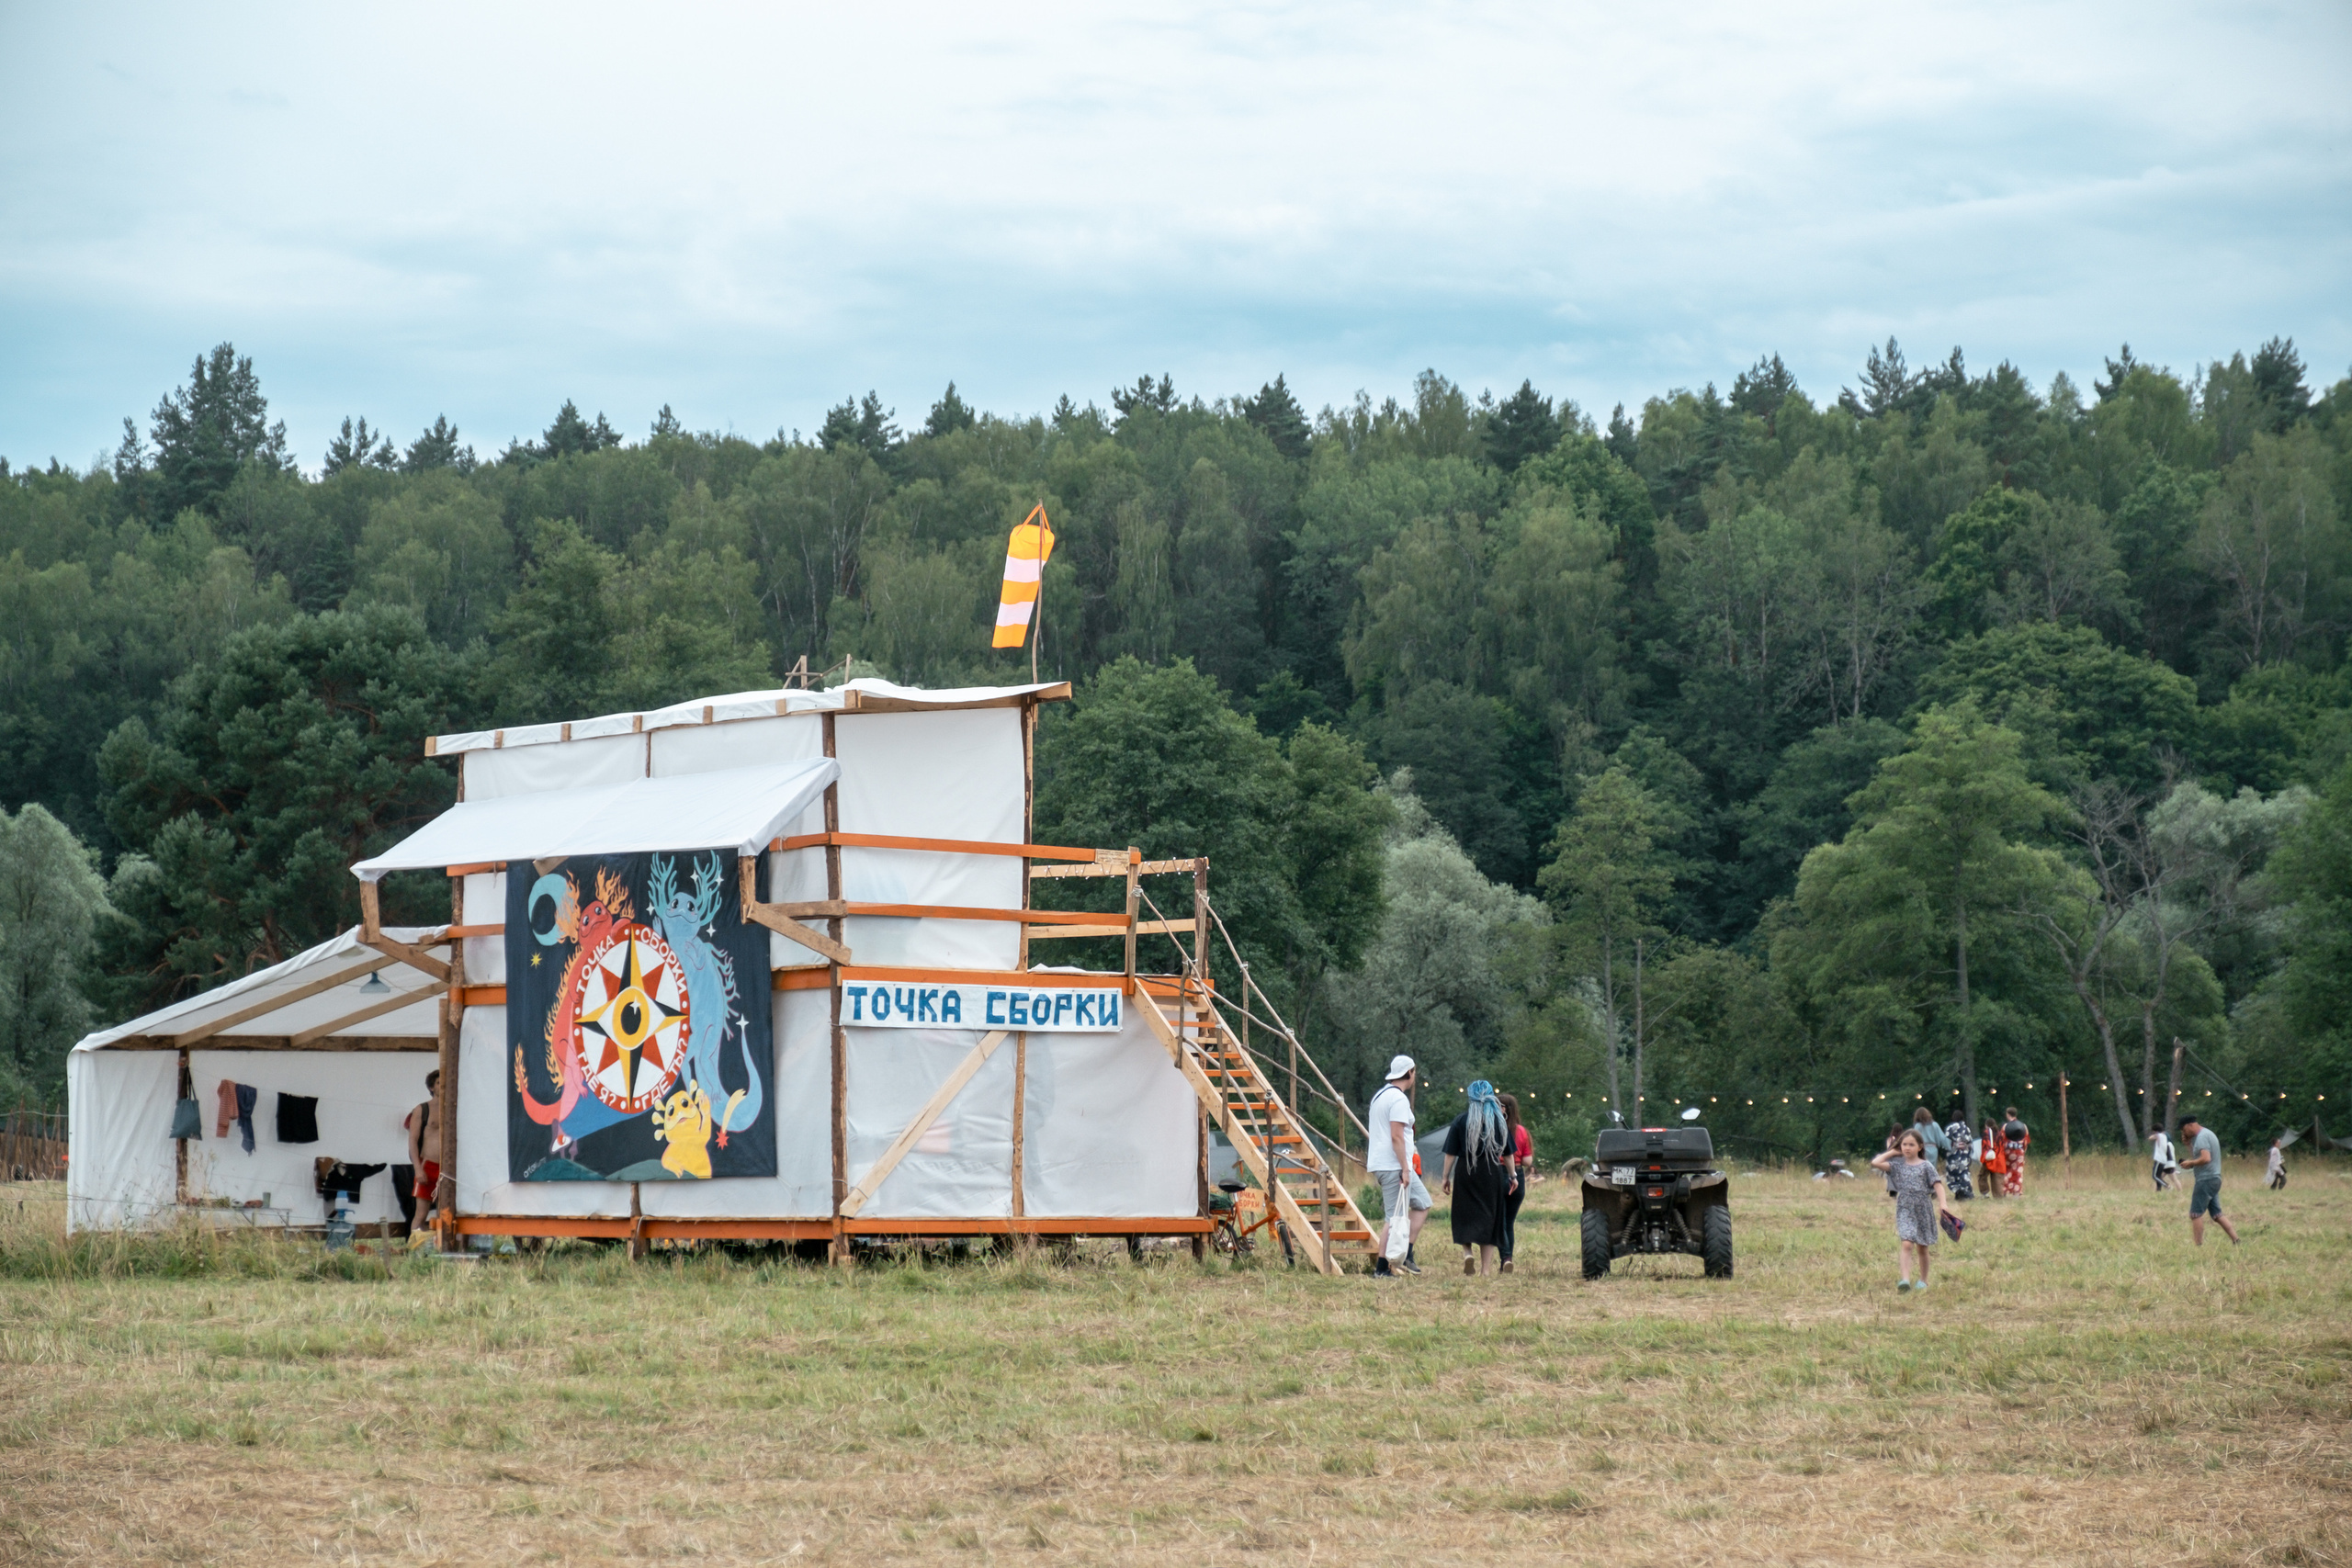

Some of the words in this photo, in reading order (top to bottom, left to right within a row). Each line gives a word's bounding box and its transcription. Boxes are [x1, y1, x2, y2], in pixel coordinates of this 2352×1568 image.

[576, 934, 616, 993] ТОЧКА
[640, 927, 687, 995] СБОРКИ
[847, 987, 962, 1022] ТОЧКА
[986, 991, 1119, 1026] СБОРКИ
[577, 1051, 600, 1092] ГДЕ
[598, 1089, 617, 1107] Я?
[641, 1075, 672, 1111] ГДЕ
[668, 1037, 688, 1076] ТЫ?
[1238, 1200, 1260, 1208] БОРКИ
